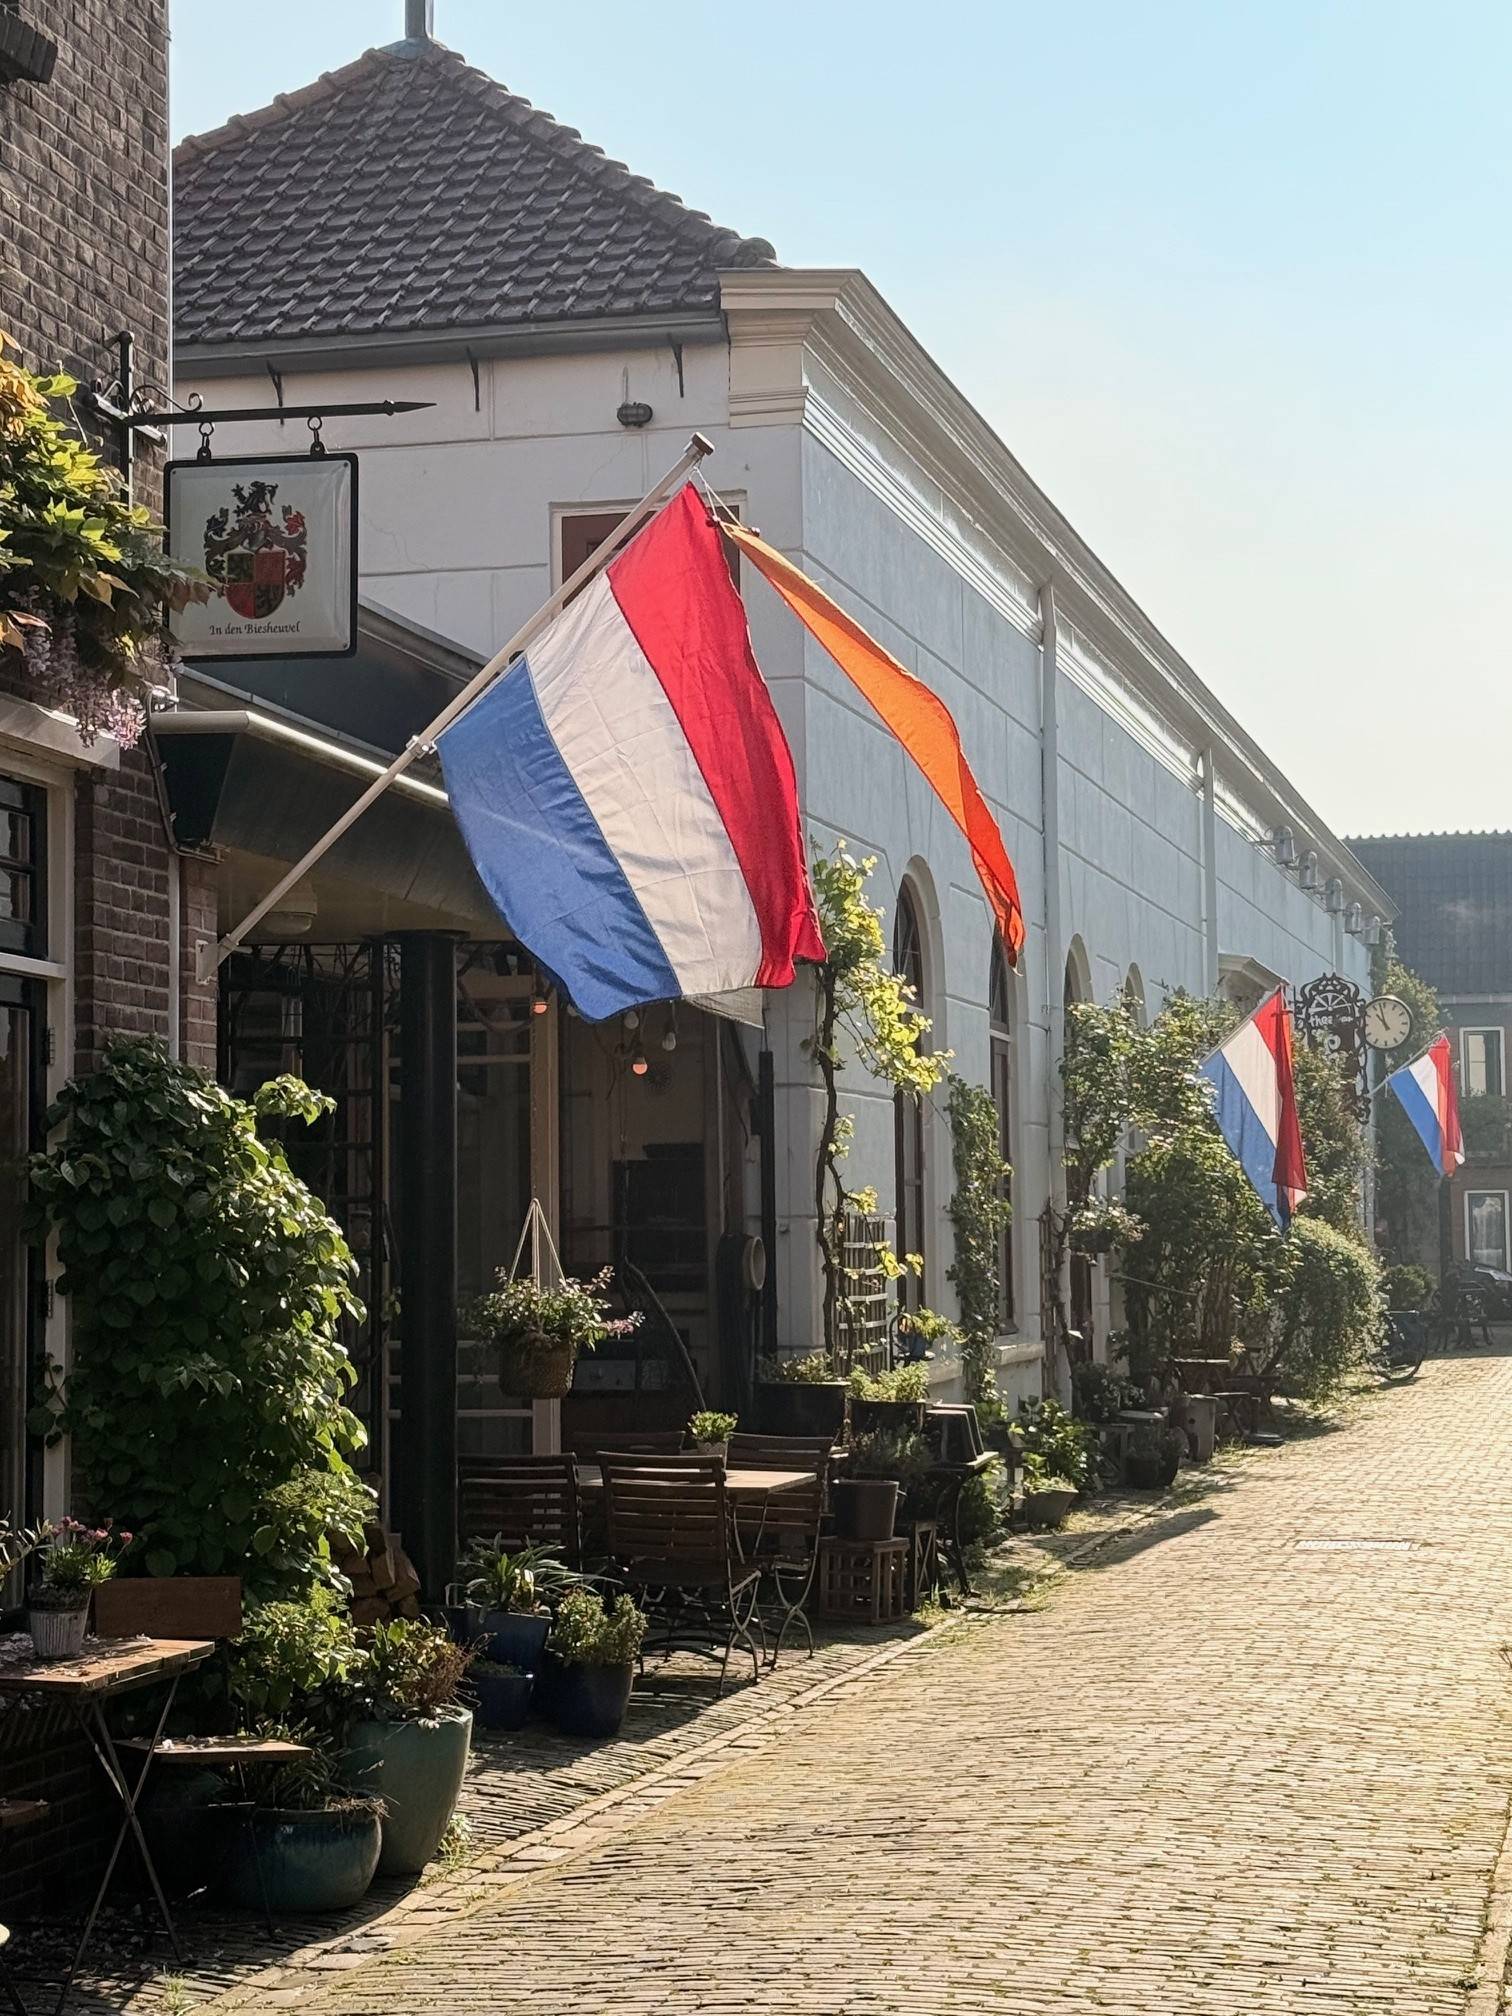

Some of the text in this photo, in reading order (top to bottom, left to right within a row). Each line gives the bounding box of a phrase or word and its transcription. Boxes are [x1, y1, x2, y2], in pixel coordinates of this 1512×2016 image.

[209, 620, 301, 636] In den Biesheuvel
